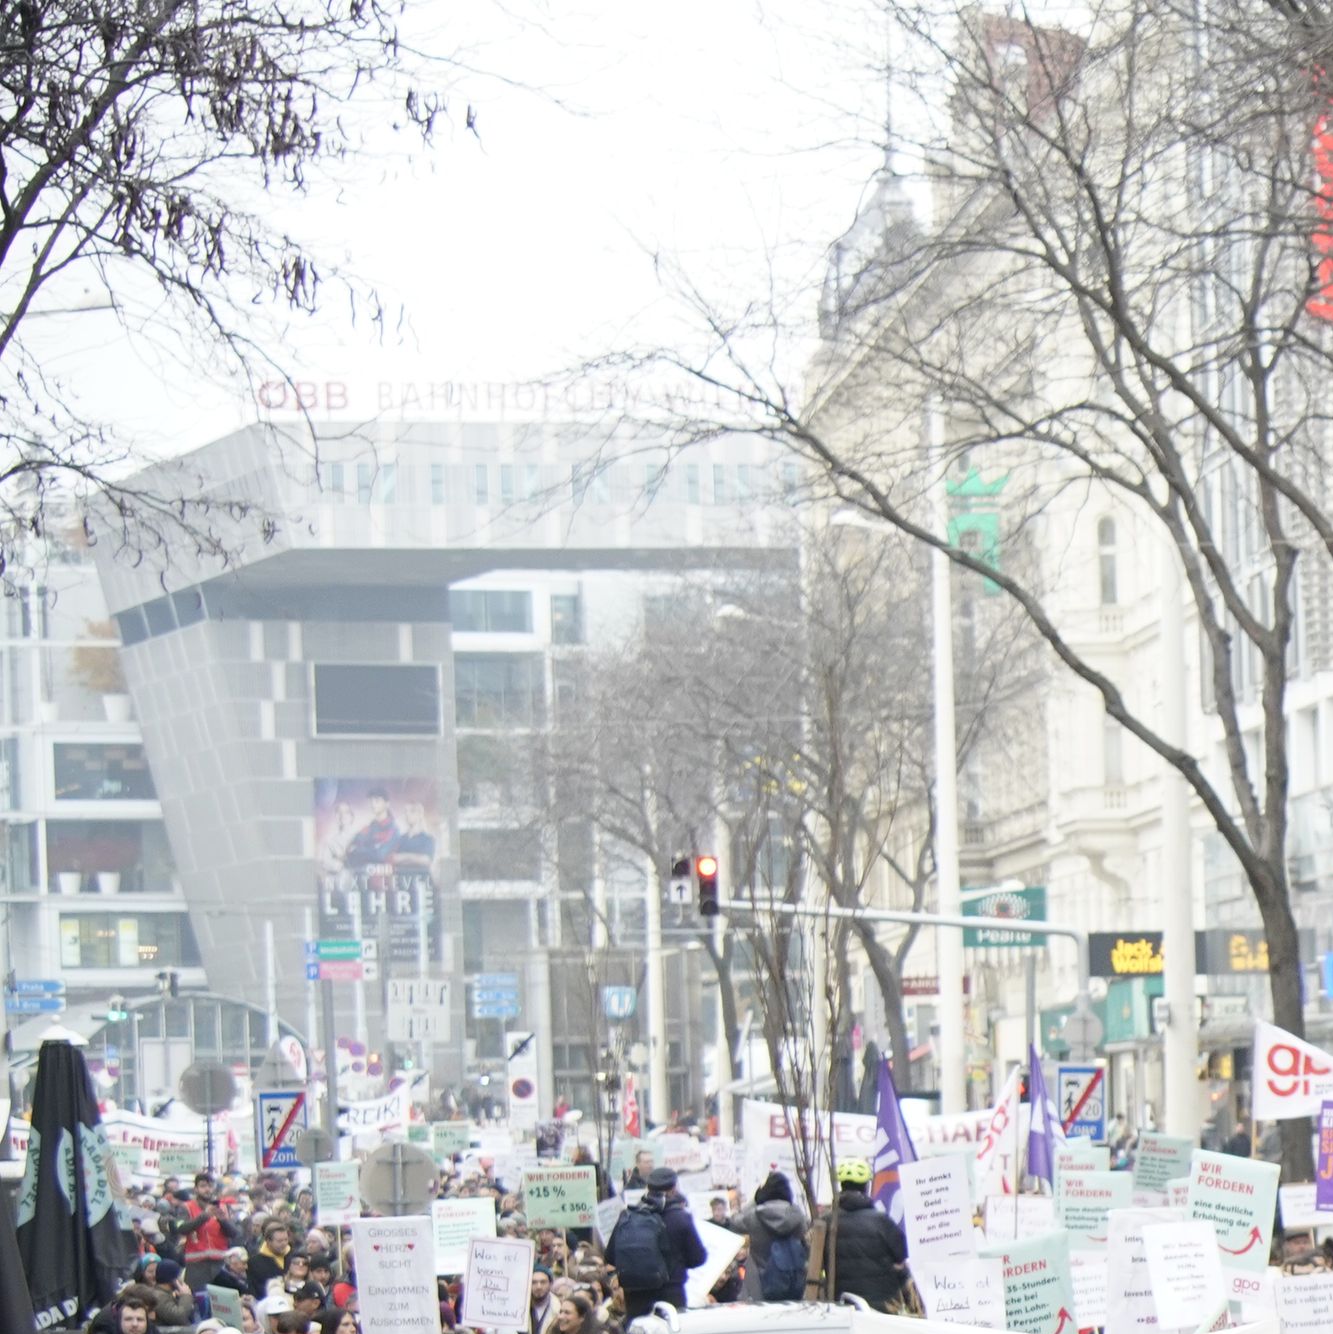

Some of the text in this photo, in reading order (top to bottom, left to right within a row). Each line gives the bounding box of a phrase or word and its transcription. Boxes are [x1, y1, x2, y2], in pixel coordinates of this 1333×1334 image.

[1085, 1103, 1099, 1116] 20
[1200, 1161, 1222, 1174] WIR
[546, 1172, 590, 1181] FORDERN
[928, 1173, 952, 1184] denkt
[1065, 1179, 1084, 1188] WIR
[1197, 1175, 1255, 1195] FORDERN
[528, 1185, 566, 1198] +15 %
[920, 1189, 933, 1197] nur
[1065, 1188, 1112, 1198] FORDERN
[924, 1198, 942, 1208] Geld
[1194, 1199, 1254, 1217] eine deutliche
[930, 1207, 960, 1219] denken
[1192, 1210, 1251, 1229] Erhöhung der
[368, 1227, 418, 1238] GROSSES
[379, 1260, 412, 1269] SUCHT
[368, 1285, 430, 1296] EINKOMMEN
[1232, 1277, 1261, 1294] gpa
[1023, 1293, 1038, 1302] bei
[388, 1302, 410, 1311] ZUM
[1025, 1303, 1050, 1314] Lohn-
[1313, 1306, 1329, 1315] und
[370, 1317, 434, 1328] AUSKOMMEN
